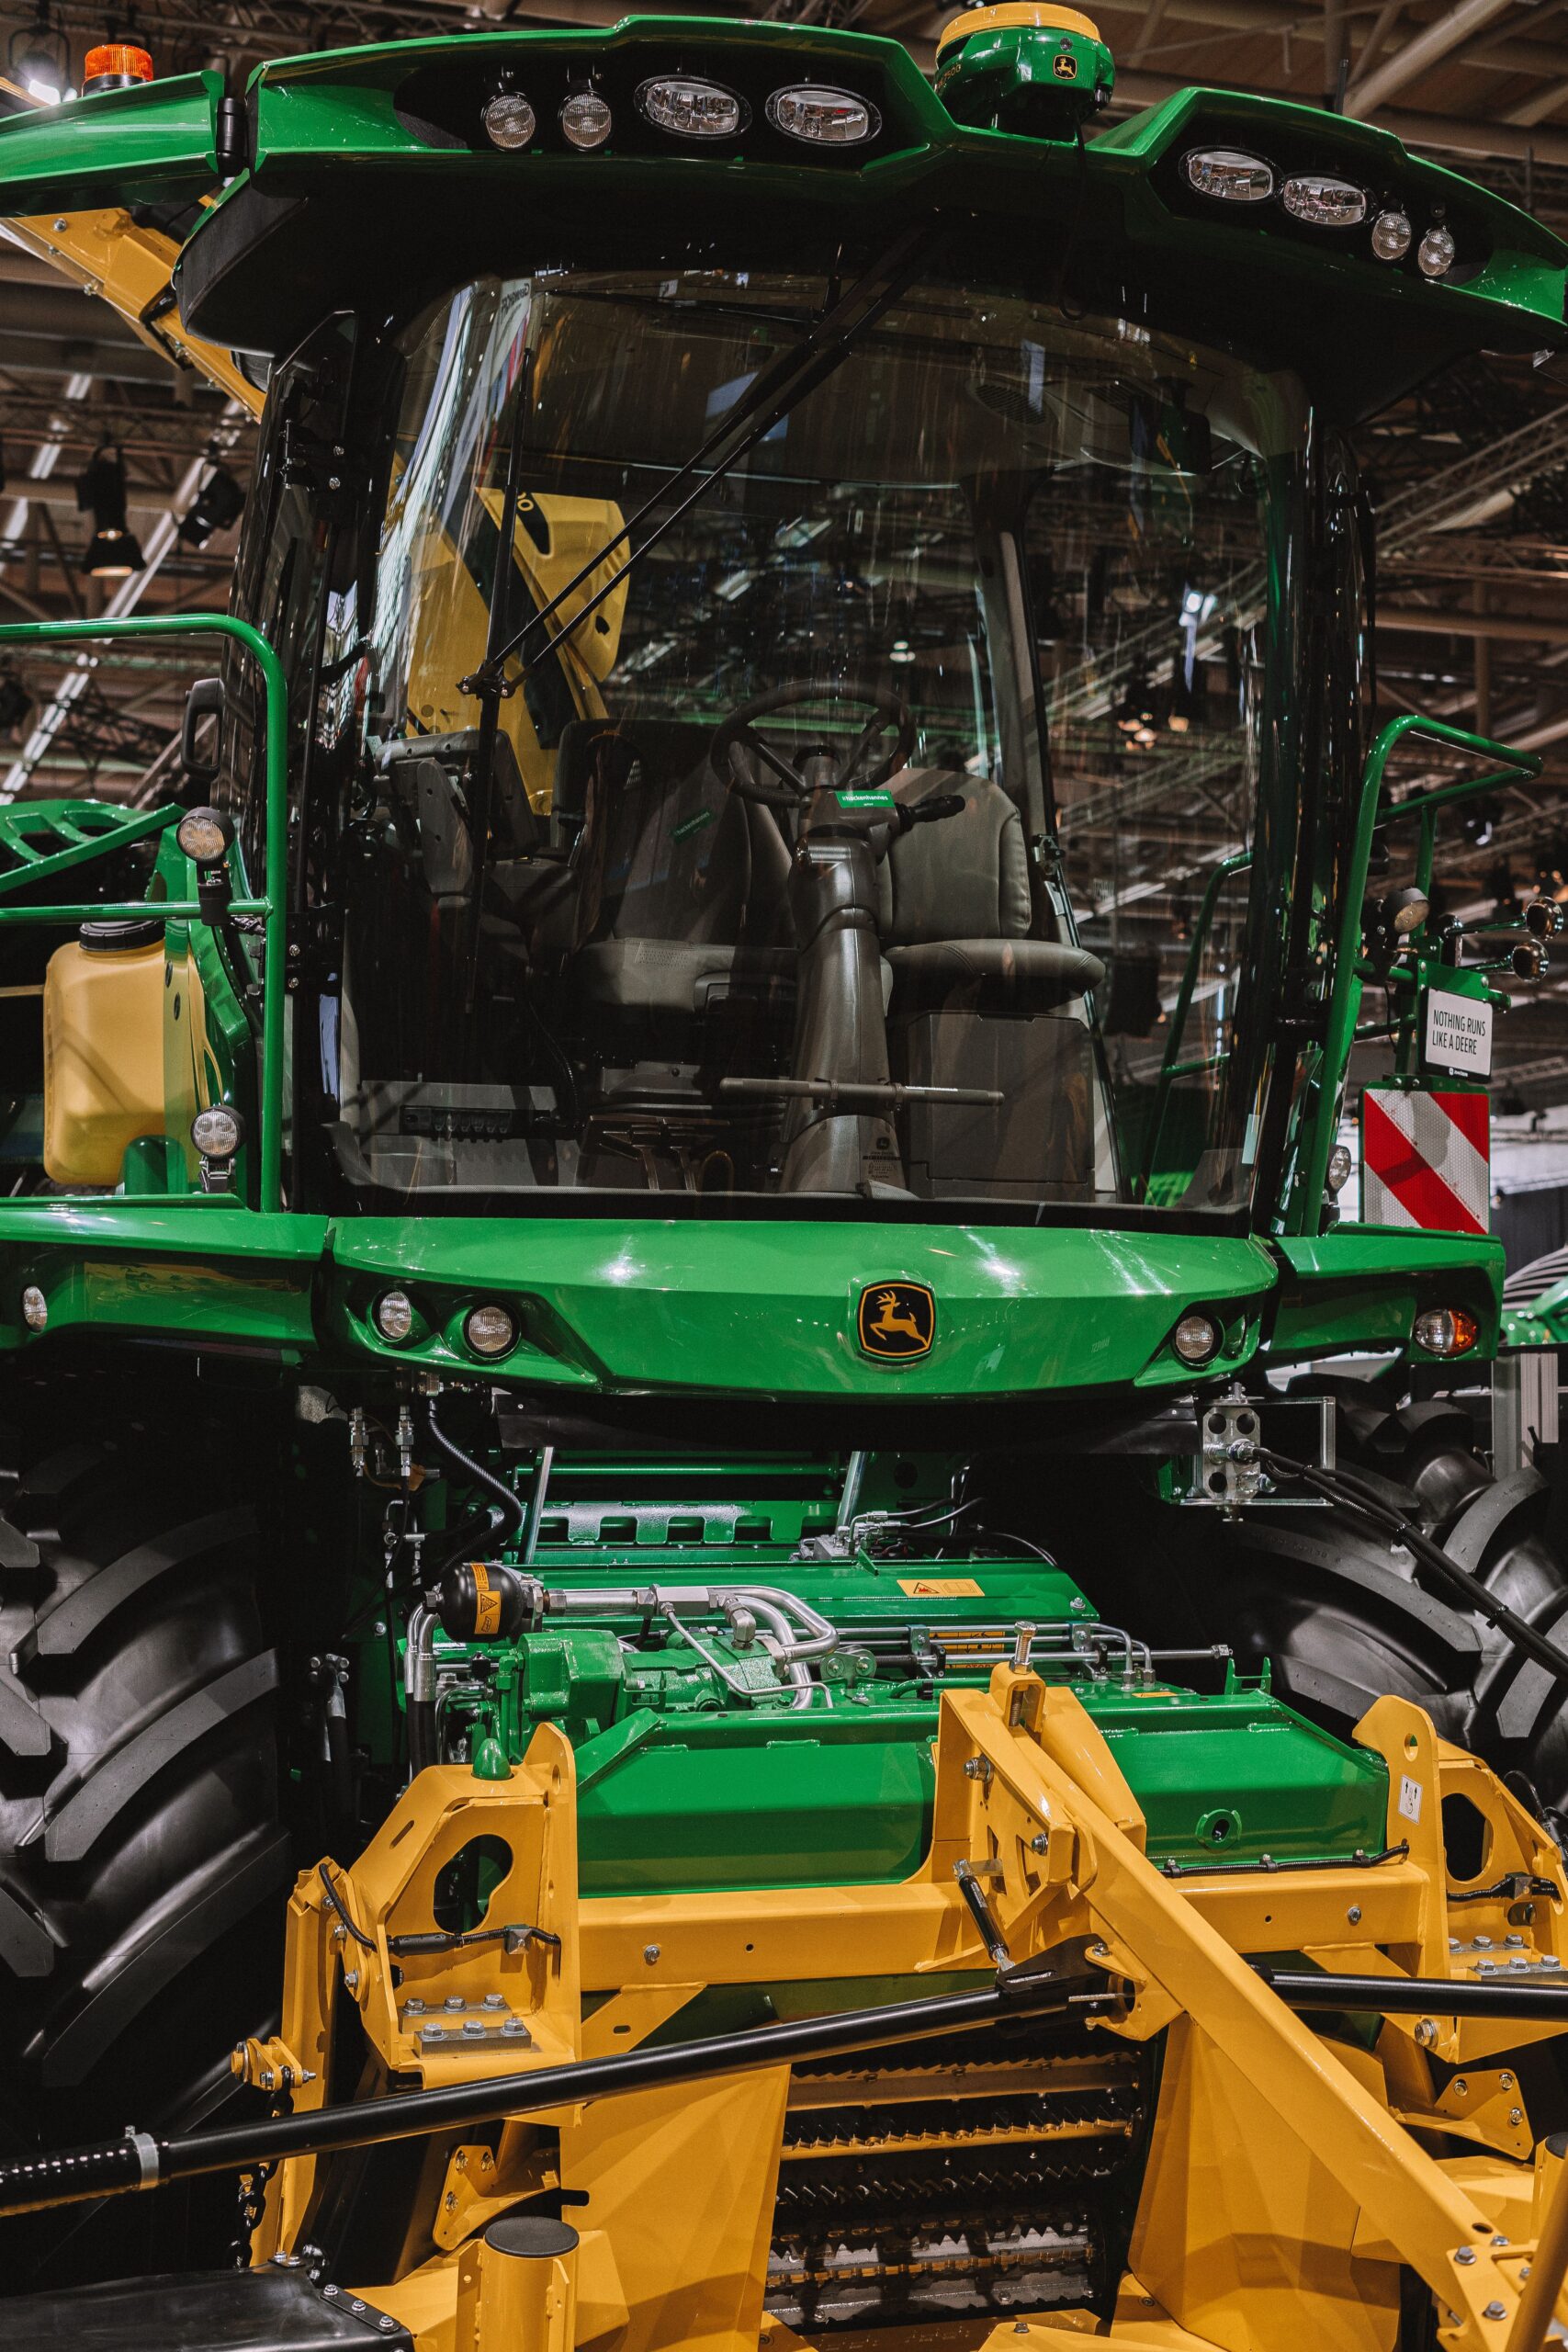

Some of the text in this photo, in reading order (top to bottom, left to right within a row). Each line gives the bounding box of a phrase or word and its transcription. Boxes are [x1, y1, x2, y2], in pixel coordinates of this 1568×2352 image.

[1433, 1009, 1485, 1037] NOTHING RUNS
[1432, 1030, 1478, 1056] LIKE A DEERE
